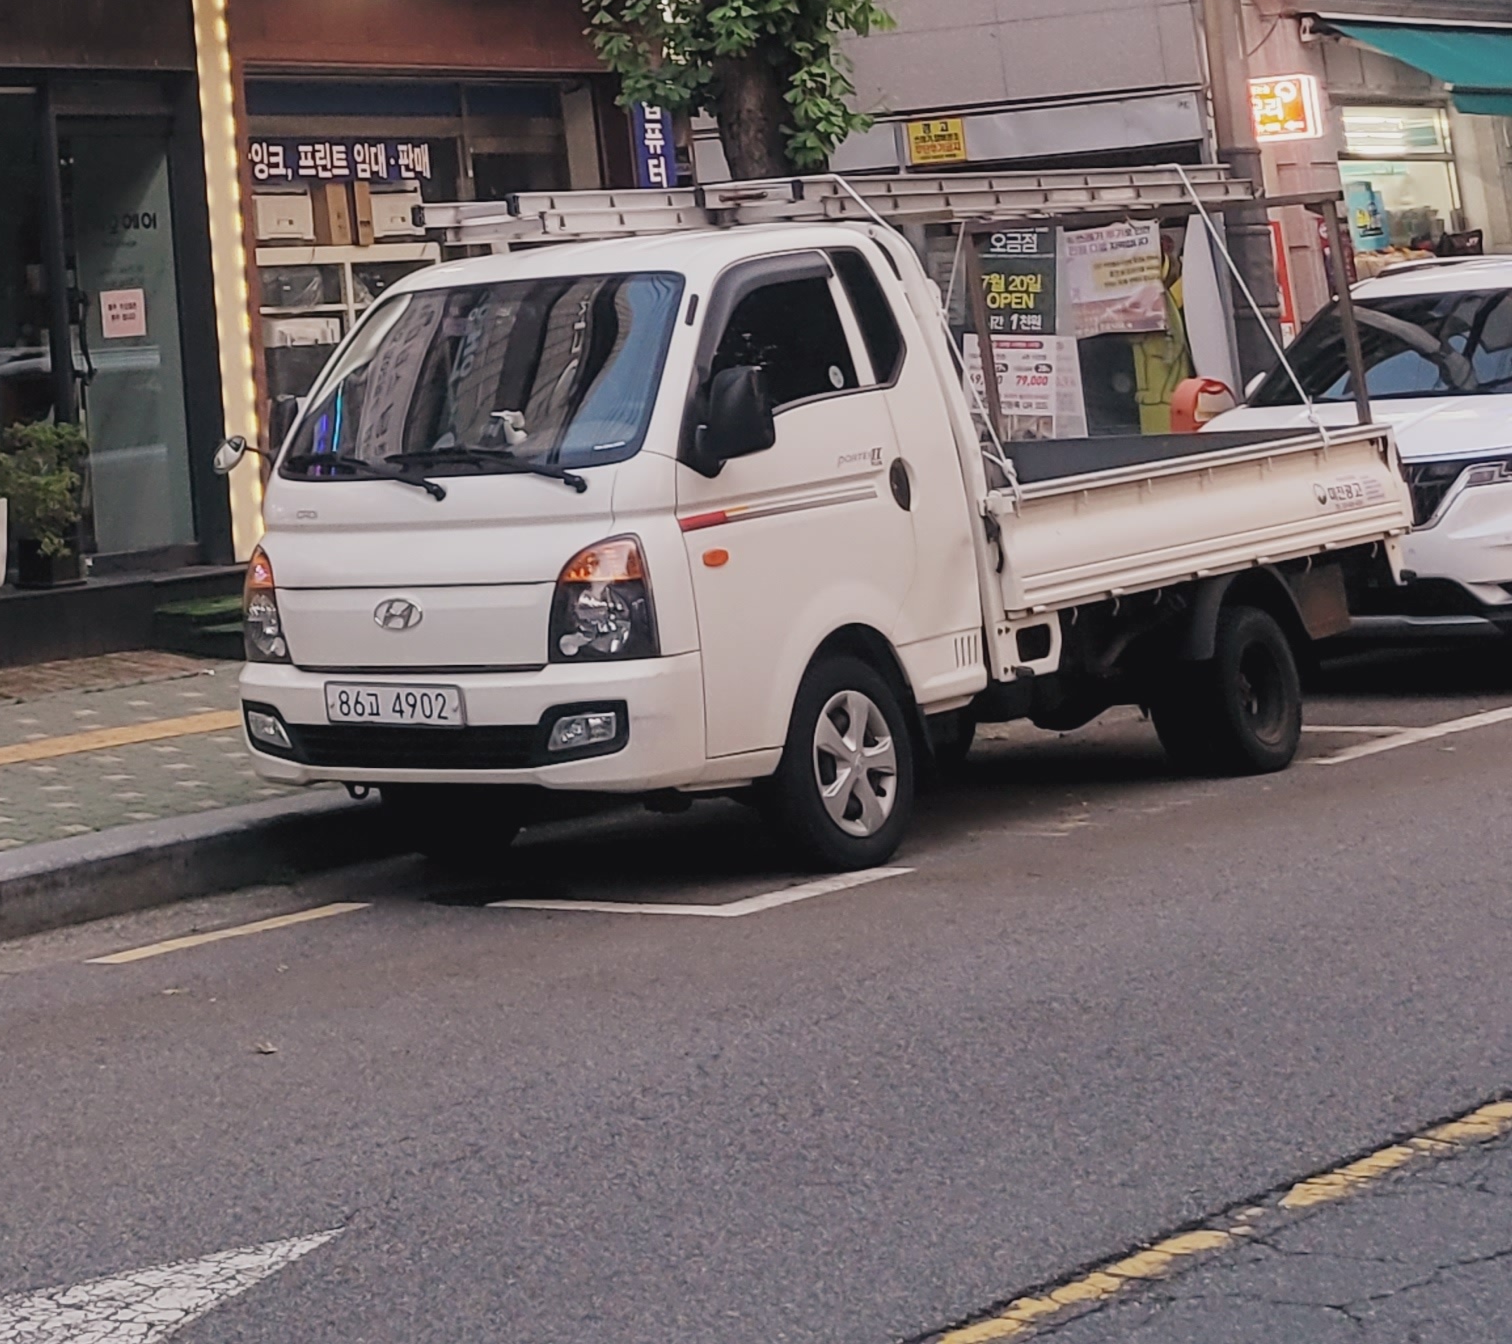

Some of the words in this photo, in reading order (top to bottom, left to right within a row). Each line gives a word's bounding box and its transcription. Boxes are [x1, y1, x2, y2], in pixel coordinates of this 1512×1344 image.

[298, 141, 350, 179] 프린트
[989, 233, 1038, 253] 오금점
[981, 273, 1006, 293] 7월
[1008, 273, 1042, 293] 20일
[986, 292, 1035, 309] OPEN
[1016, 374, 1048, 386] 79,000
[391, 691, 449, 720] 4902
